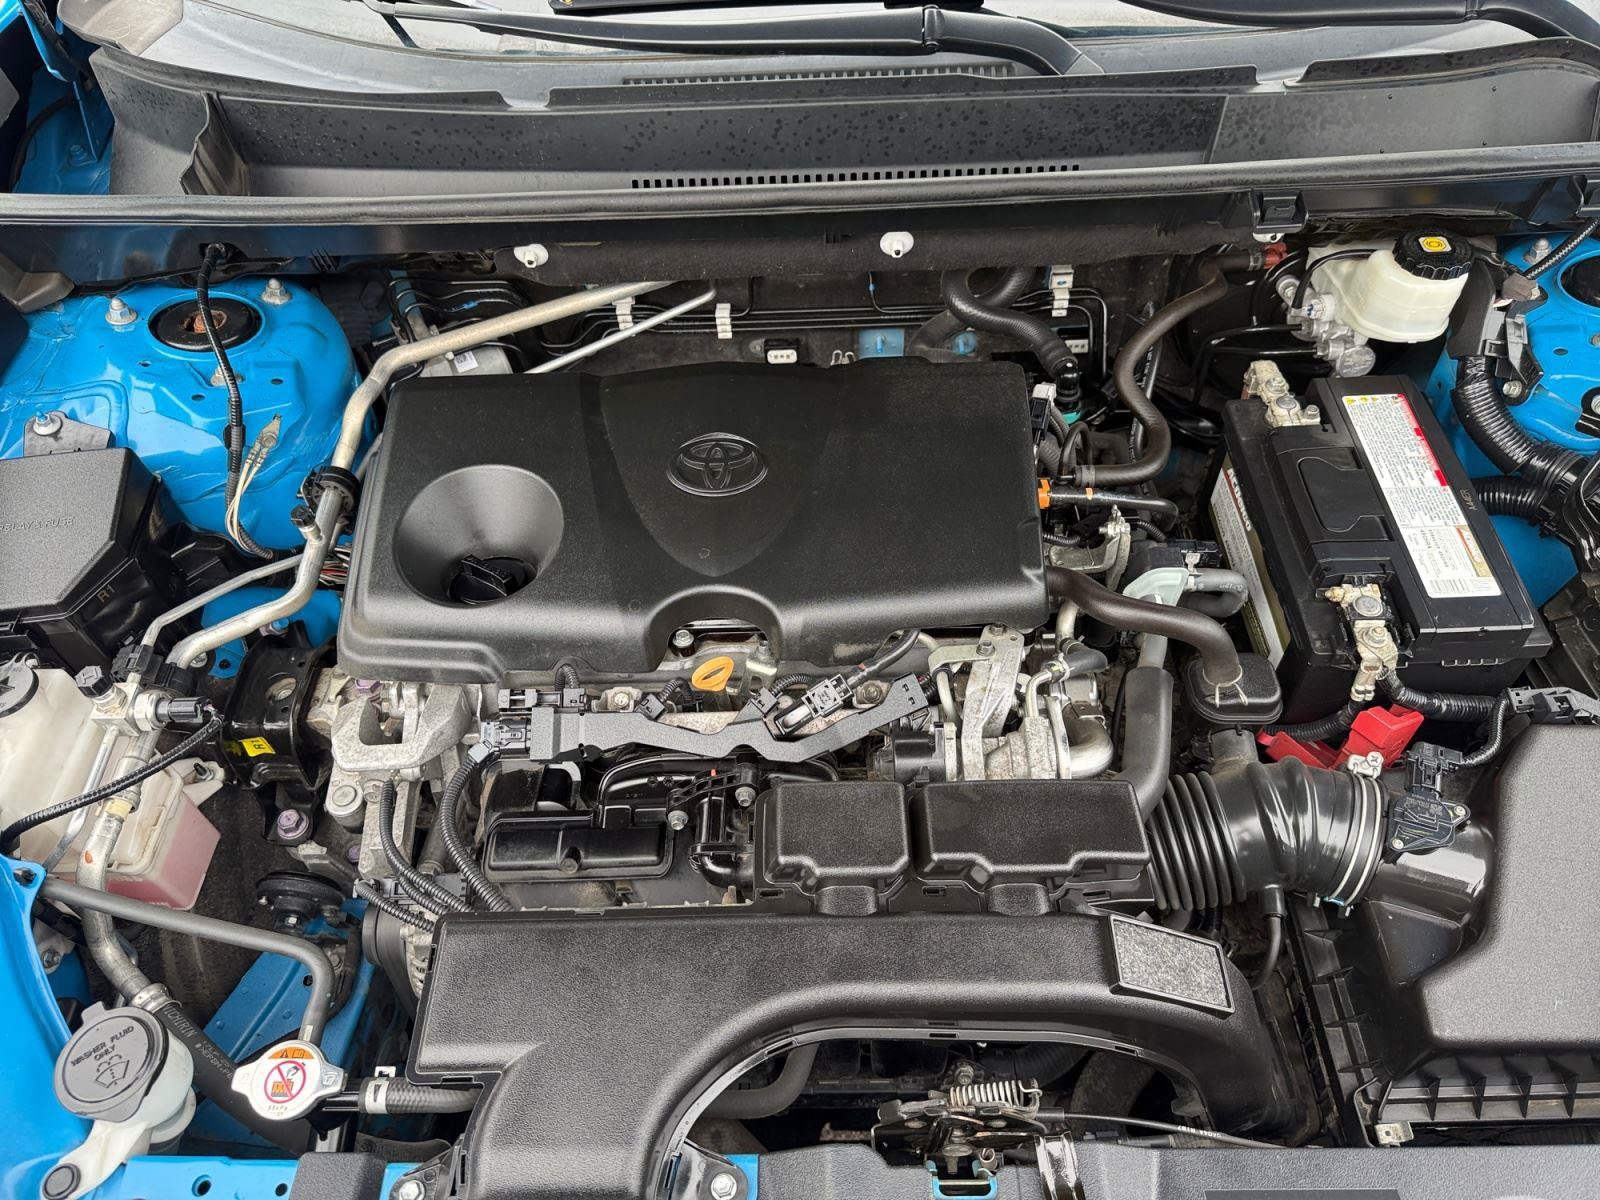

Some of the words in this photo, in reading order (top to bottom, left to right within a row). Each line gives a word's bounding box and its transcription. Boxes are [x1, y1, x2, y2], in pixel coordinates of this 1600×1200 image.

[45, 516, 75, 529] FUSE
[70, 1041, 106, 1067] WASHER
[110, 1025, 134, 1043] FLUID
[94, 1043, 115, 1061] ONLY
